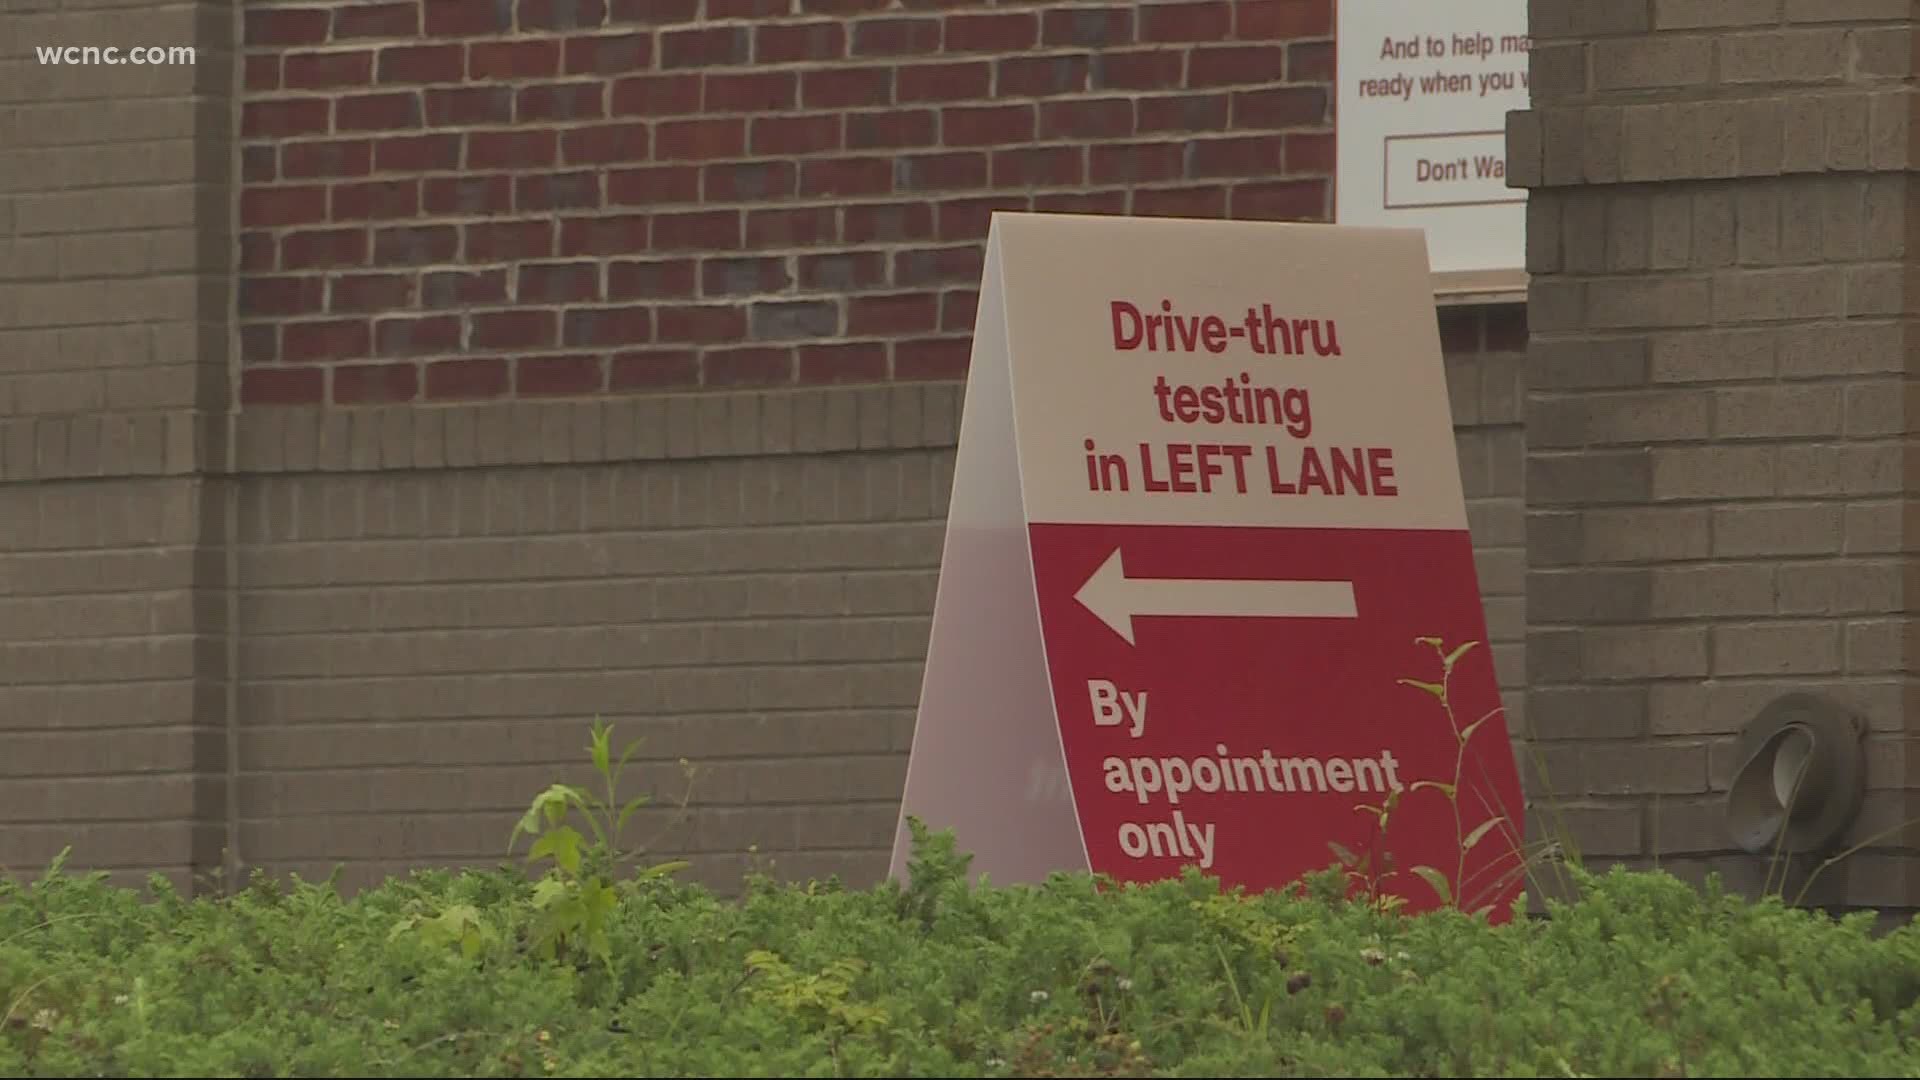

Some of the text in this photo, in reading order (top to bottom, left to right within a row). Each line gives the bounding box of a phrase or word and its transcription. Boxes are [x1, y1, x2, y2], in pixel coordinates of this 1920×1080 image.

[1380, 32, 1528, 61] And to help ma
[1359, 73, 1414, 100] ready
[1420, 71, 1472, 94] when
[1478, 71, 1514, 96] you
[1416, 155, 1505, 182] Don't Wa
[1111, 300, 1341, 357] Drive-thru
[1154, 372, 1312, 439] testing
[1084, 439, 1398, 496] in LEFT LANE
[1087, 679, 1147, 738] By
[1103, 743, 1404, 804] appointment
[1118, 810, 1216, 868] only
